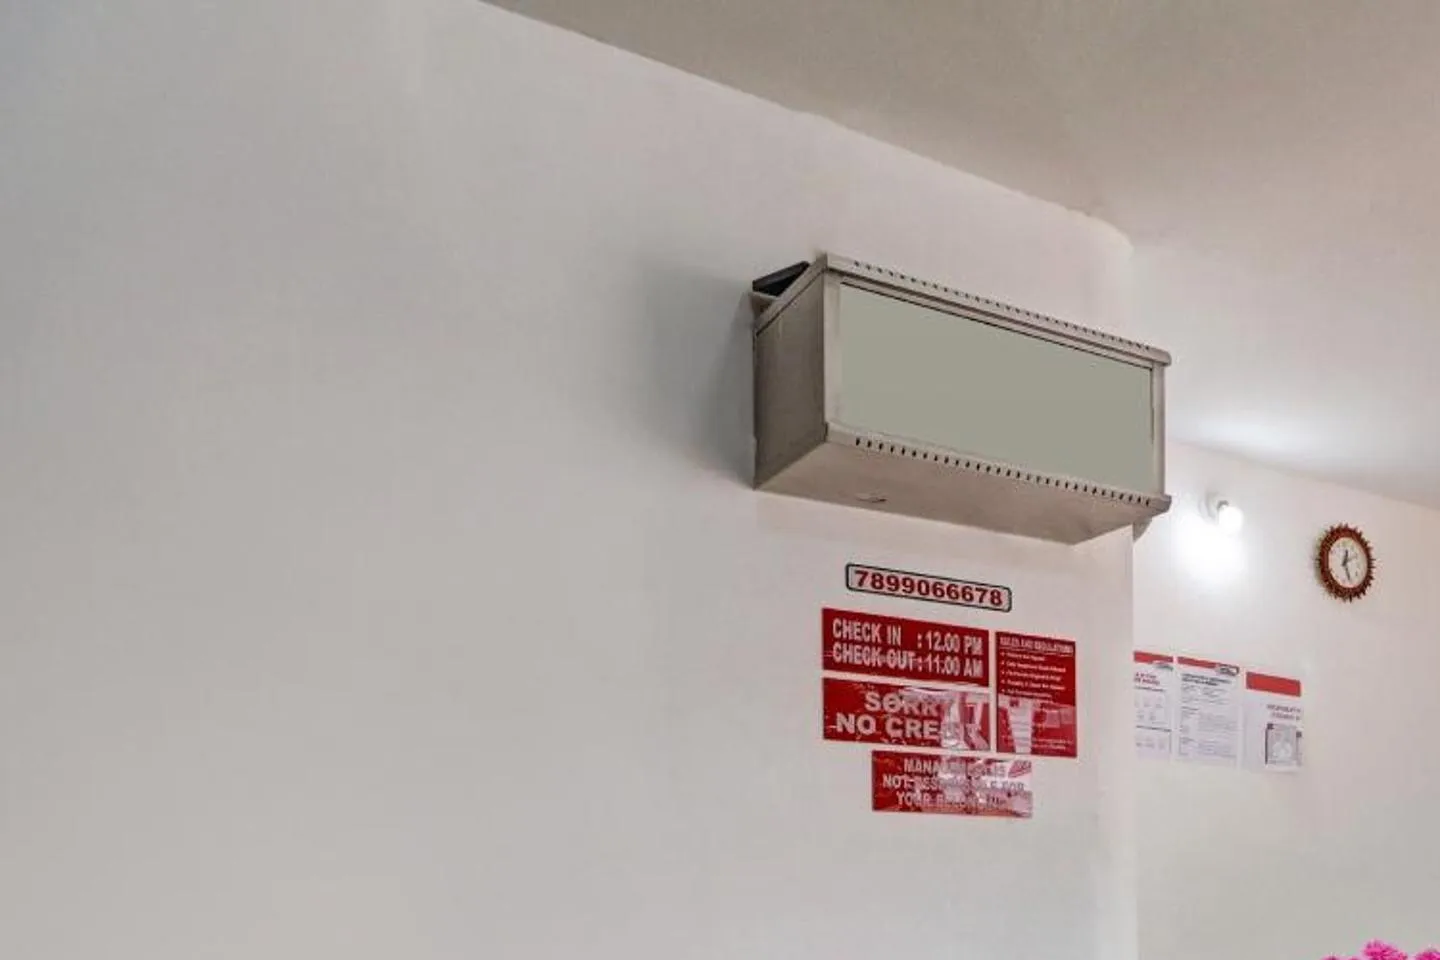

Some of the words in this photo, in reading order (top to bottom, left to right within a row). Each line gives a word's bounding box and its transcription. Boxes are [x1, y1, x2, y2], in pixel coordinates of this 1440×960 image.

[854, 570, 1003, 606] 7899066678
[832, 617, 882, 644] CHECK
[887, 624, 902, 646] IN
[963, 635, 984, 655] PM
[963, 658, 984, 678] AM
[864, 691, 956, 718] SORR
[836, 713, 877, 736] NO
